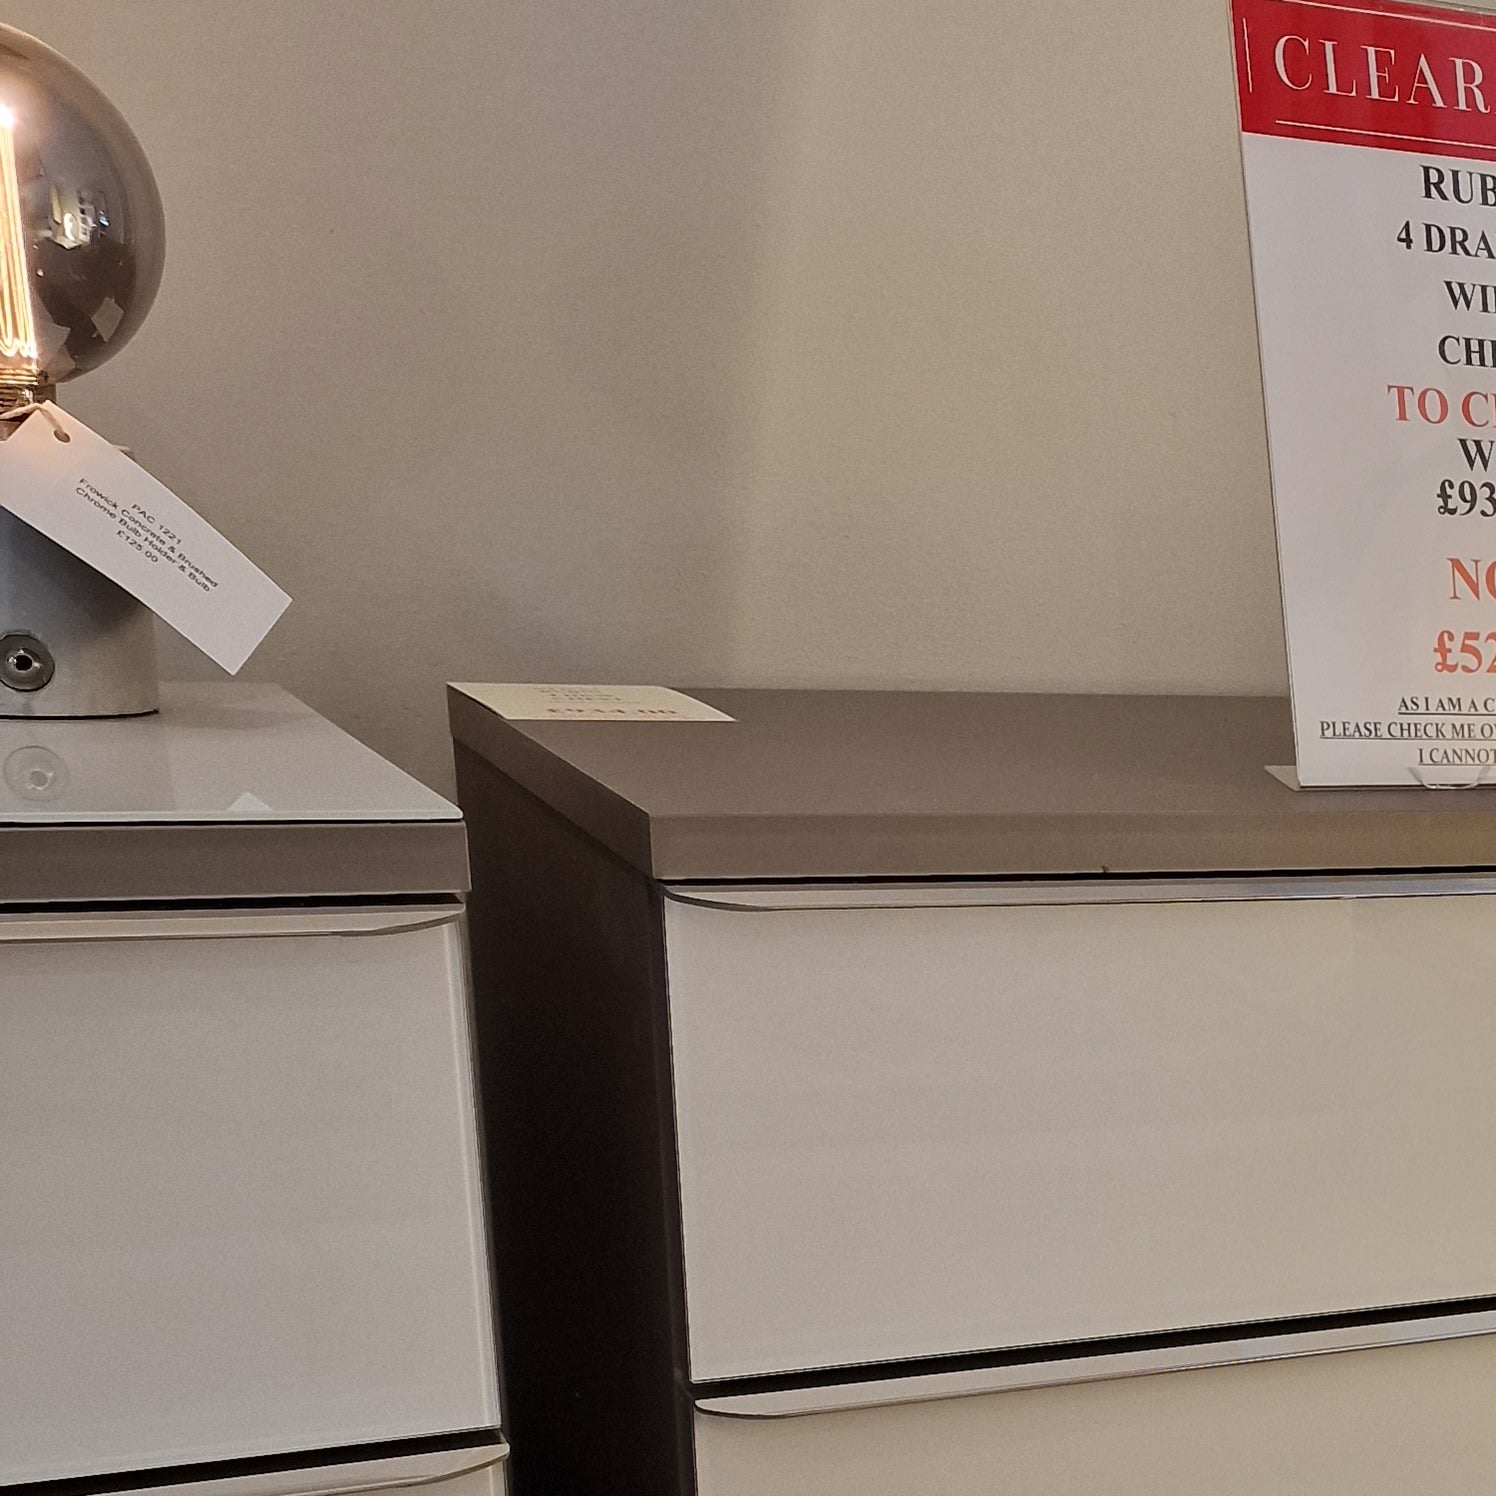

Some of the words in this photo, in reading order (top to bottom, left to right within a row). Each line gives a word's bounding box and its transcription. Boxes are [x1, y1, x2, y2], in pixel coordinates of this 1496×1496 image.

[1396, 220, 1414, 250] 4
[1386, 384, 1450, 425] TO
[76, 487, 117, 519] Chrome
[118, 518, 142, 538] Bulb
[143, 537, 177, 564] Holder
[188, 572, 210, 592] Bulb
[79, 478, 118, 510] Frowick
[121, 509, 166, 546] Concrete
[177, 553, 218, 588] Brushed
[131, 504, 156, 524] PAC
[159, 525, 182, 545] 1221
[1398, 696, 1420, 711] AS
[1424, 697, 1430, 711] I
[1436, 697, 1462, 712] AM
[1468, 698, 1479, 712] A
[1320, 720, 1383, 738] PLEASE
[1387, 721, 1447, 738] CHECK
[1451, 722, 1476, 739] ME
[1418, 748, 1424, 763] I
